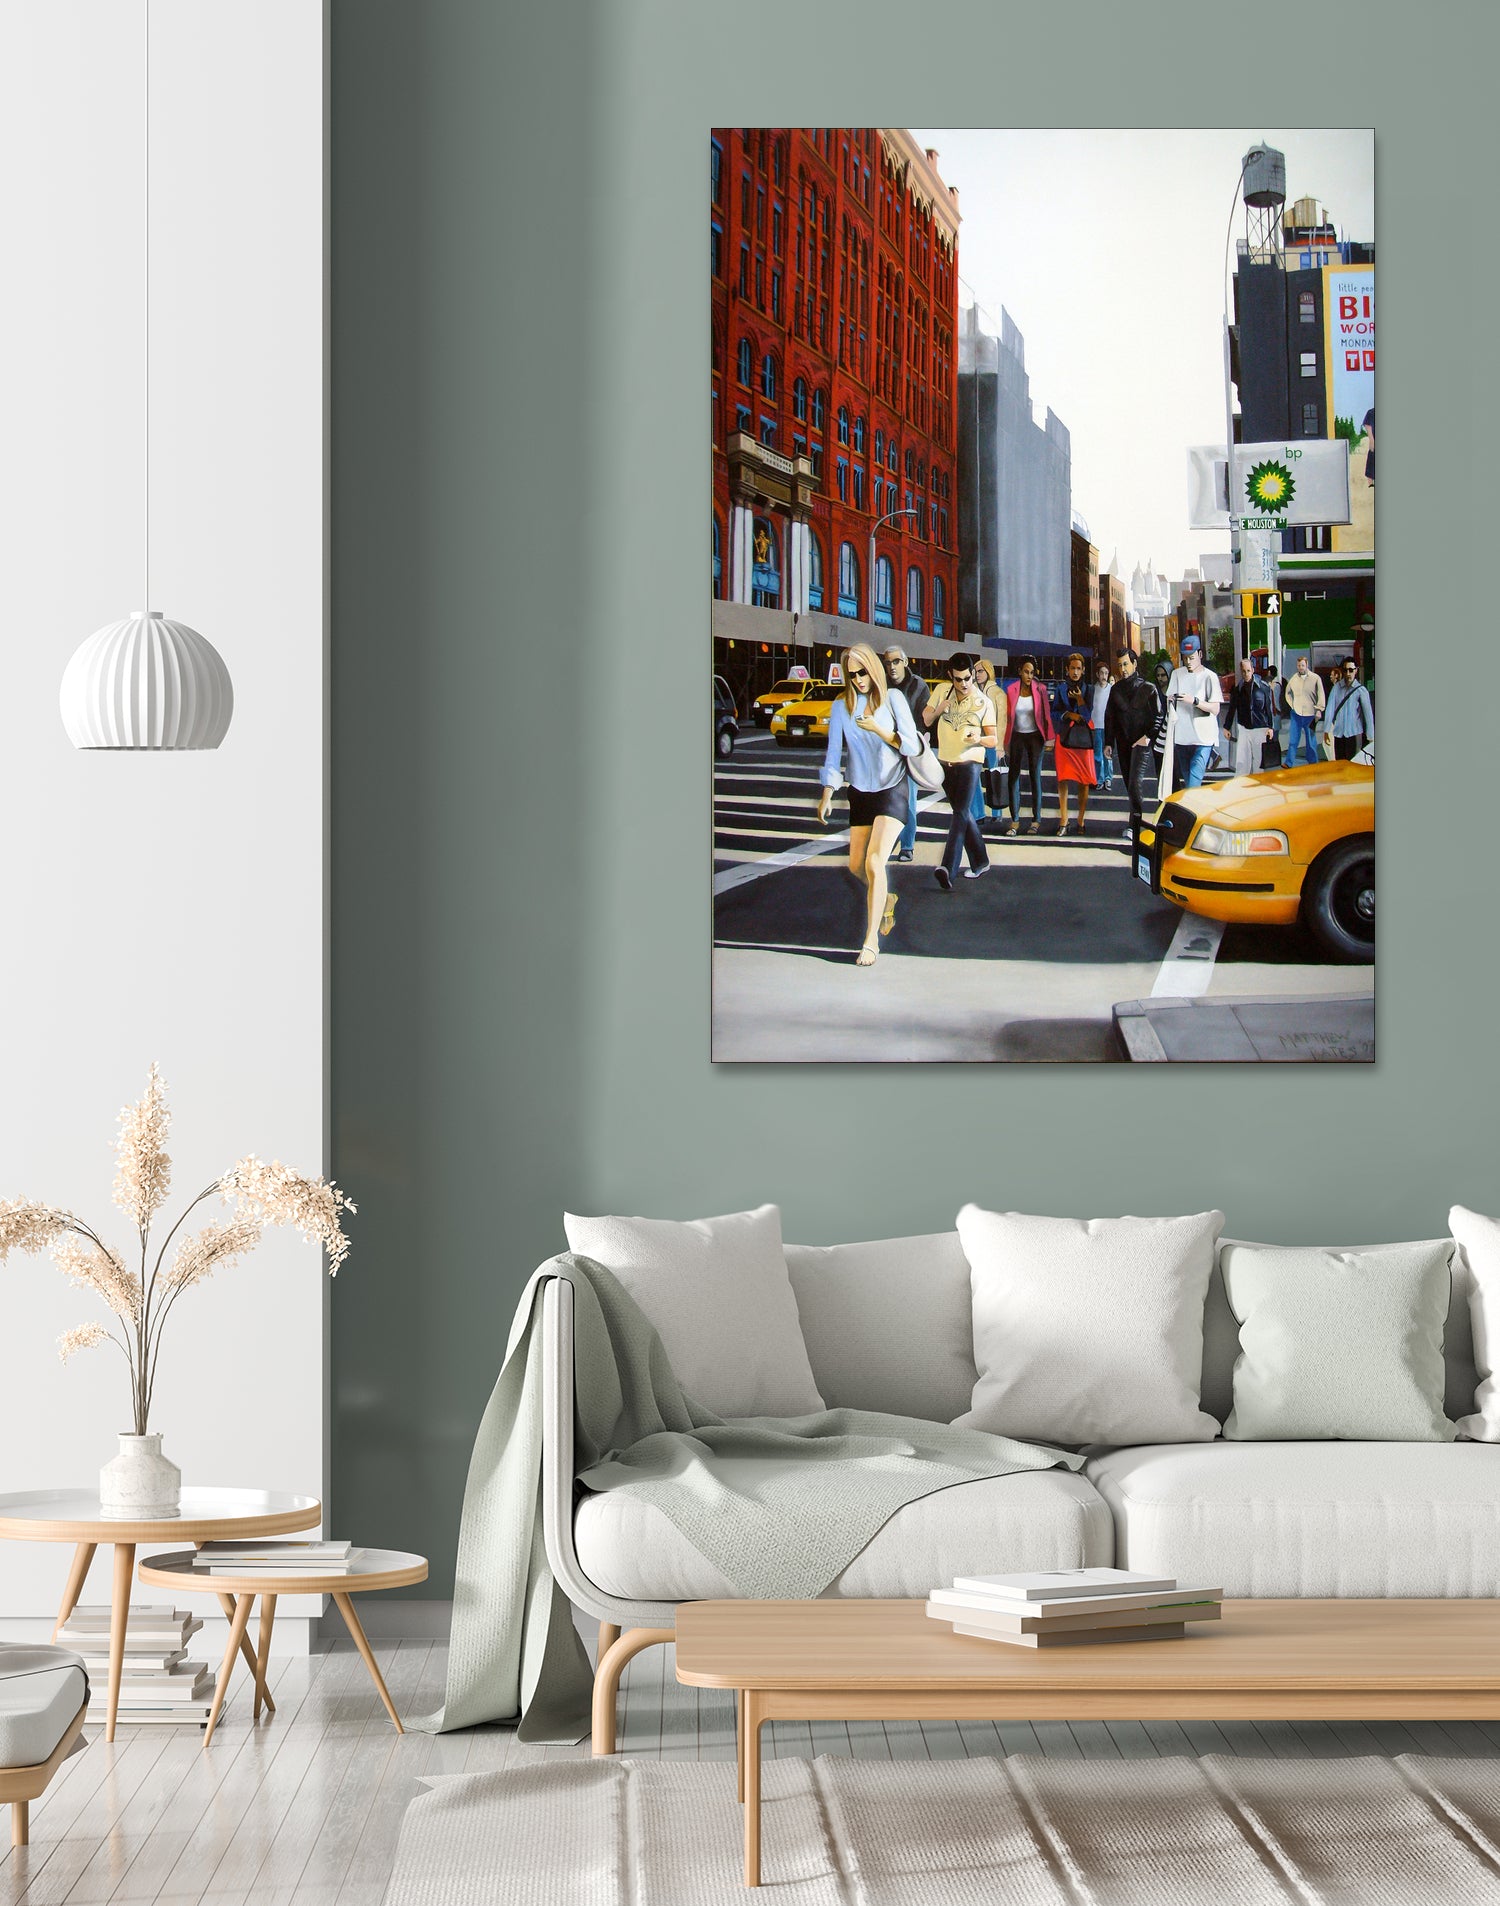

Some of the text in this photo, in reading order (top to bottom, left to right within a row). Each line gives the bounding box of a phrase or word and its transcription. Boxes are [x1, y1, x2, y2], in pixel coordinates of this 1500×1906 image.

[1338, 283, 1358, 292] little
[1339, 295, 1375, 320] BI
[1285, 446, 1303, 461] bp
[1241, 519, 1246, 529] E
[1247, 518, 1277, 529] HOUSTON
